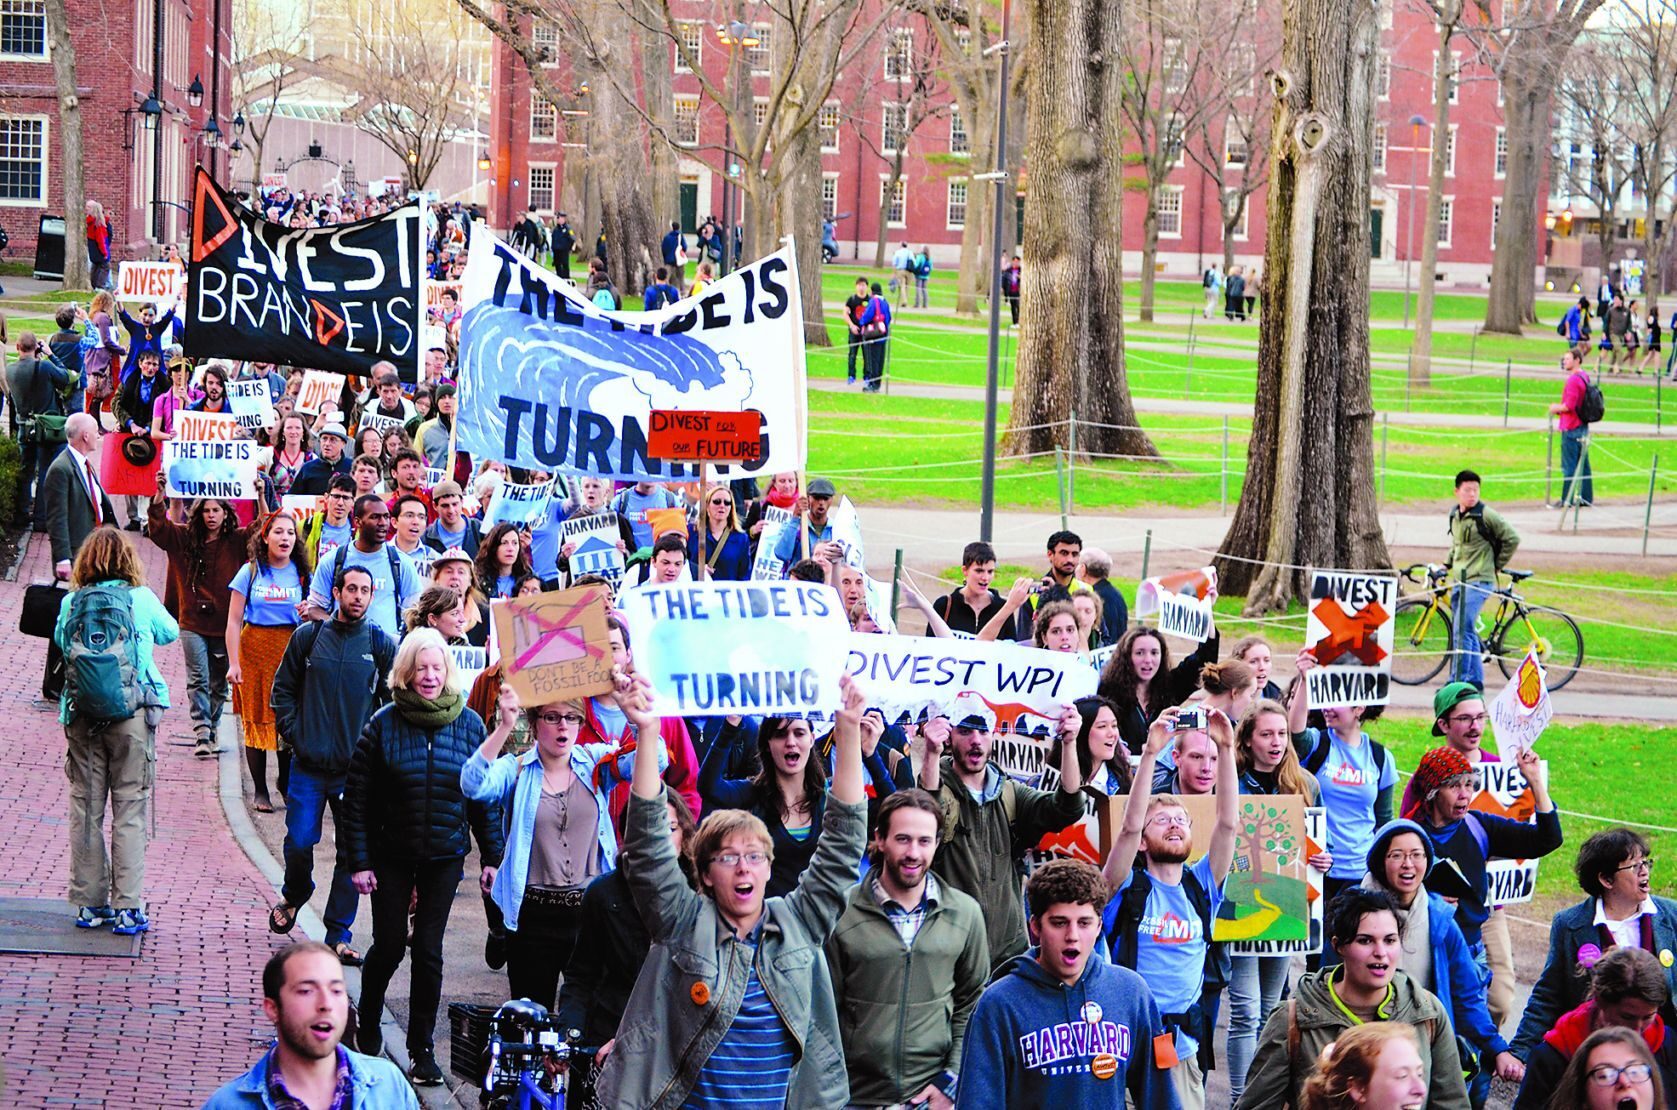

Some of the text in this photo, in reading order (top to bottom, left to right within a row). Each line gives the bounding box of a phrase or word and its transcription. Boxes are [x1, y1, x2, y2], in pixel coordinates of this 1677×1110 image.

[192, 168, 419, 291] DIVEST
[124, 267, 175, 297] DIVEST
[493, 244, 585, 327] THE
[739, 257, 788, 325] IS
[198, 266, 413, 357] BRANDEIS
[252, 382, 264, 397] IS
[361, 413, 404, 430] DIVEST
[652, 411, 736, 432] DIVEST FOR
[171, 442, 250, 460] THE TIDE IS
[672, 439, 760, 458] OUR FUTURE
[178, 480, 242, 498] TURNING
[502, 483, 528, 501] THE
[564, 511, 618, 536] HARVARD
[642, 587, 830, 620] THE TIDE IS
[1311, 575, 1393, 605] DIVEST
[1162, 601, 1210, 637] HARVARD
[572, 660, 589, 674] BE
[594, 658, 602, 670] A
[847, 650, 1064, 698] DIVEST WPI
[534, 675, 586, 695] FOSSIL
[670, 668, 820, 710] TURNING
[1309, 672, 1390, 704] HARVARD
[1138, 924, 1162, 936] FREE
[1019, 1020, 1131, 1069] HARVARD
